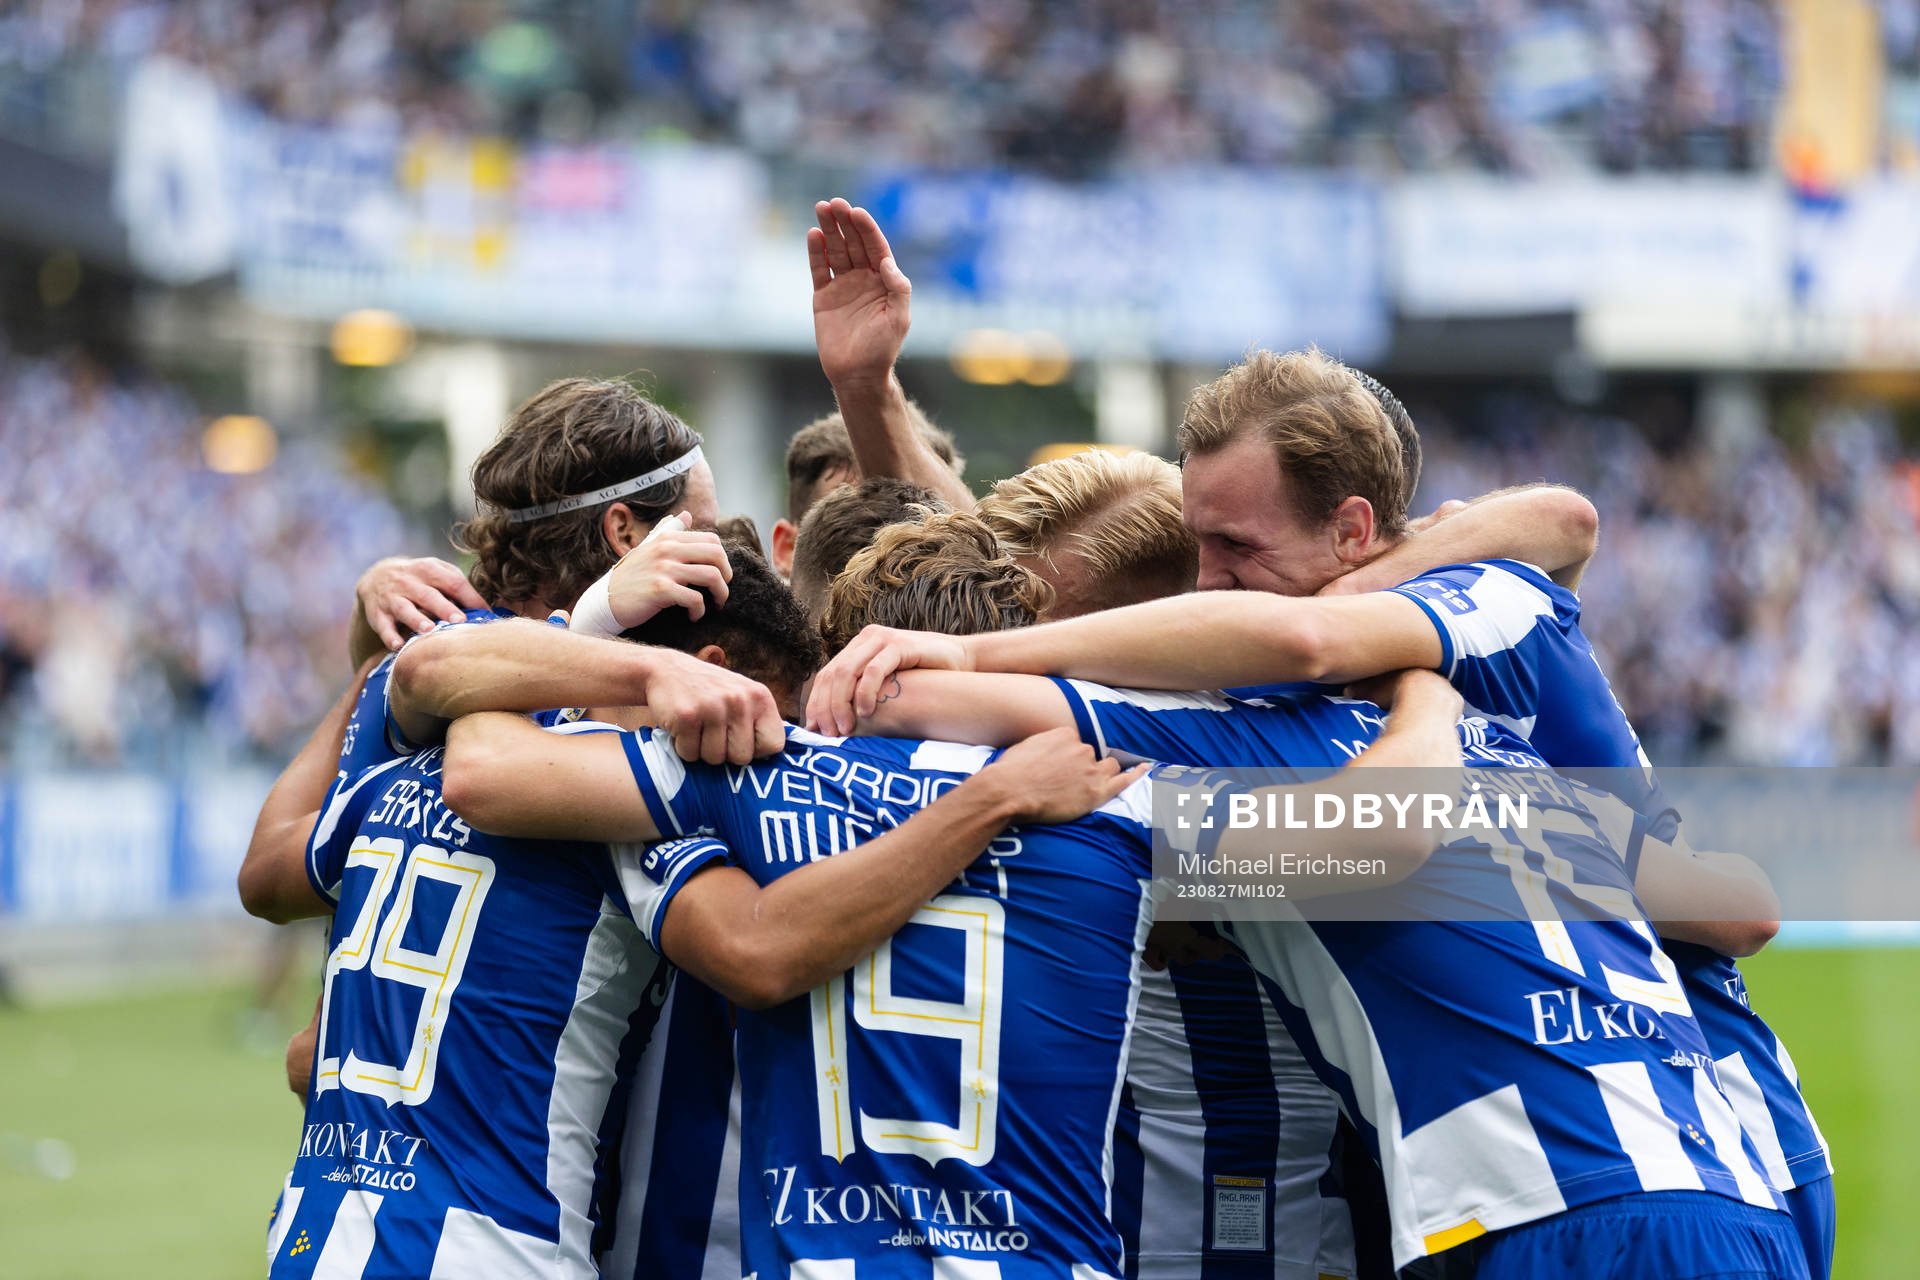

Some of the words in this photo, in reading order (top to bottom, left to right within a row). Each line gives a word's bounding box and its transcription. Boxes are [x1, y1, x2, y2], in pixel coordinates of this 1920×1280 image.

[599, 486, 623, 501] ACE
[633, 474, 656, 490] ACE
[317, 836, 497, 1109] 29
[810, 894, 1006, 1168] 19
[1524, 986, 1593, 1046] El
[298, 1122, 429, 1167] KONAKT
[351, 1163, 417, 1192] STALCO
[802, 1183, 1020, 1228] KONTAKT
[929, 1226, 1029, 1252] INSTALCO
